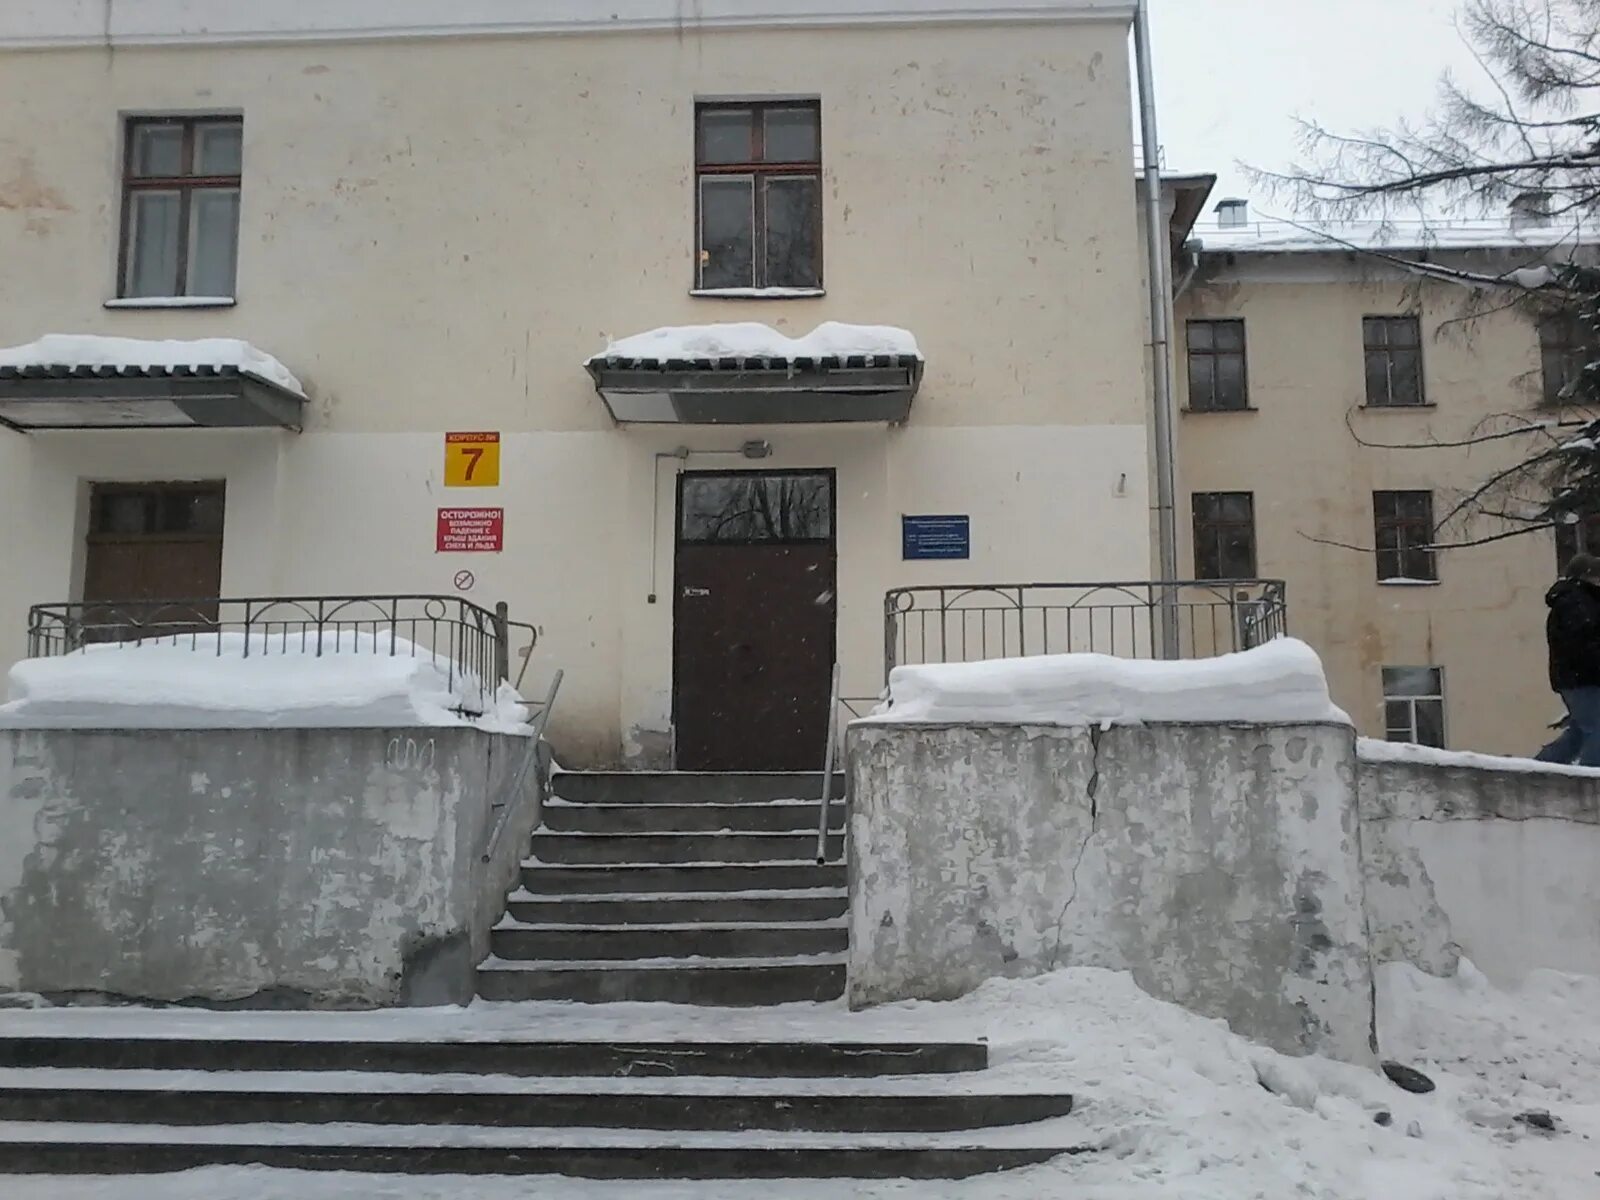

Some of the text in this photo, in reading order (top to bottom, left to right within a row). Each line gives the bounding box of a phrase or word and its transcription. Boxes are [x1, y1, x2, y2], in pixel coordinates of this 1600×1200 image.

[462, 449, 484, 480] 7
[441, 511, 501, 519] ОСТОРОЖНО!
[450, 527, 483, 535] ПАДЕНИЕ
